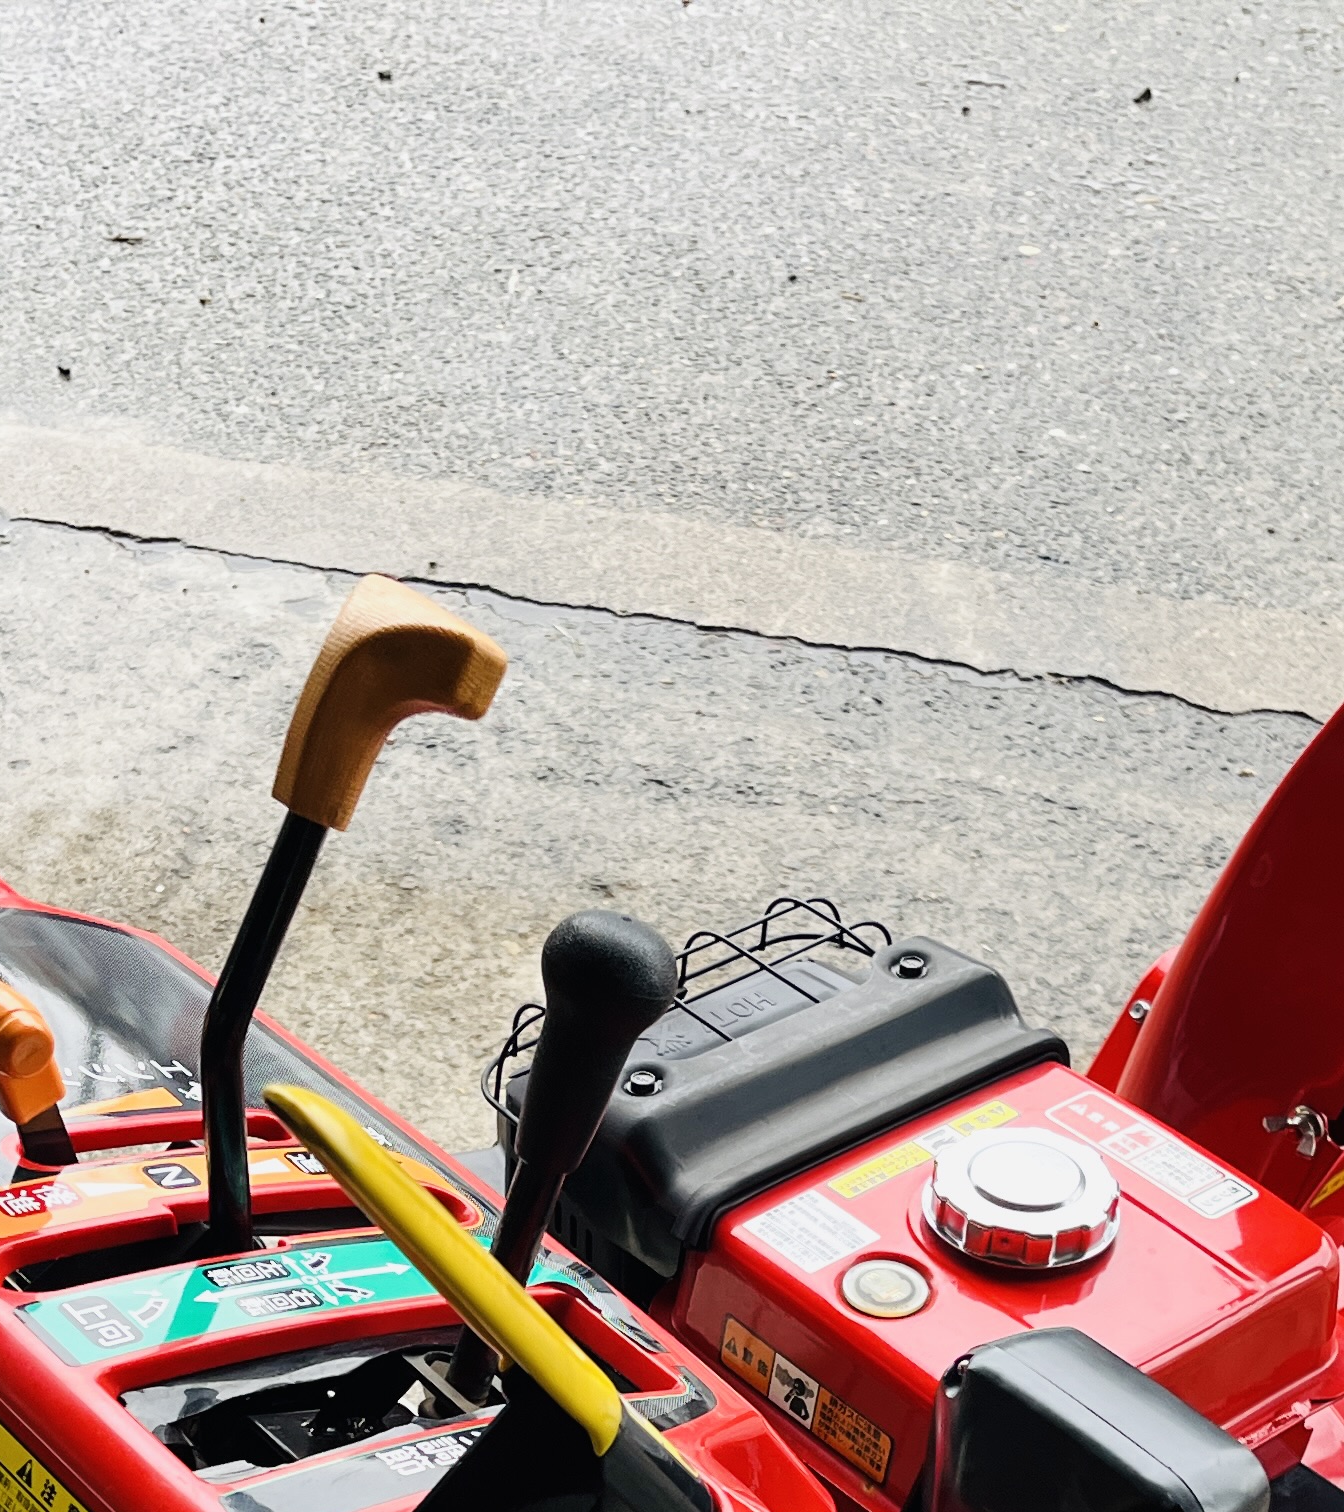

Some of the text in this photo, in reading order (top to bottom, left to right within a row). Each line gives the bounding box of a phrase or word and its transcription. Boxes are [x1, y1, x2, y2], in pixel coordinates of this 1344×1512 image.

[147, 1166, 195, 1187] N
[236, 1289, 320, 1317] 右回転
[61, 1301, 136, 1348] 上向
